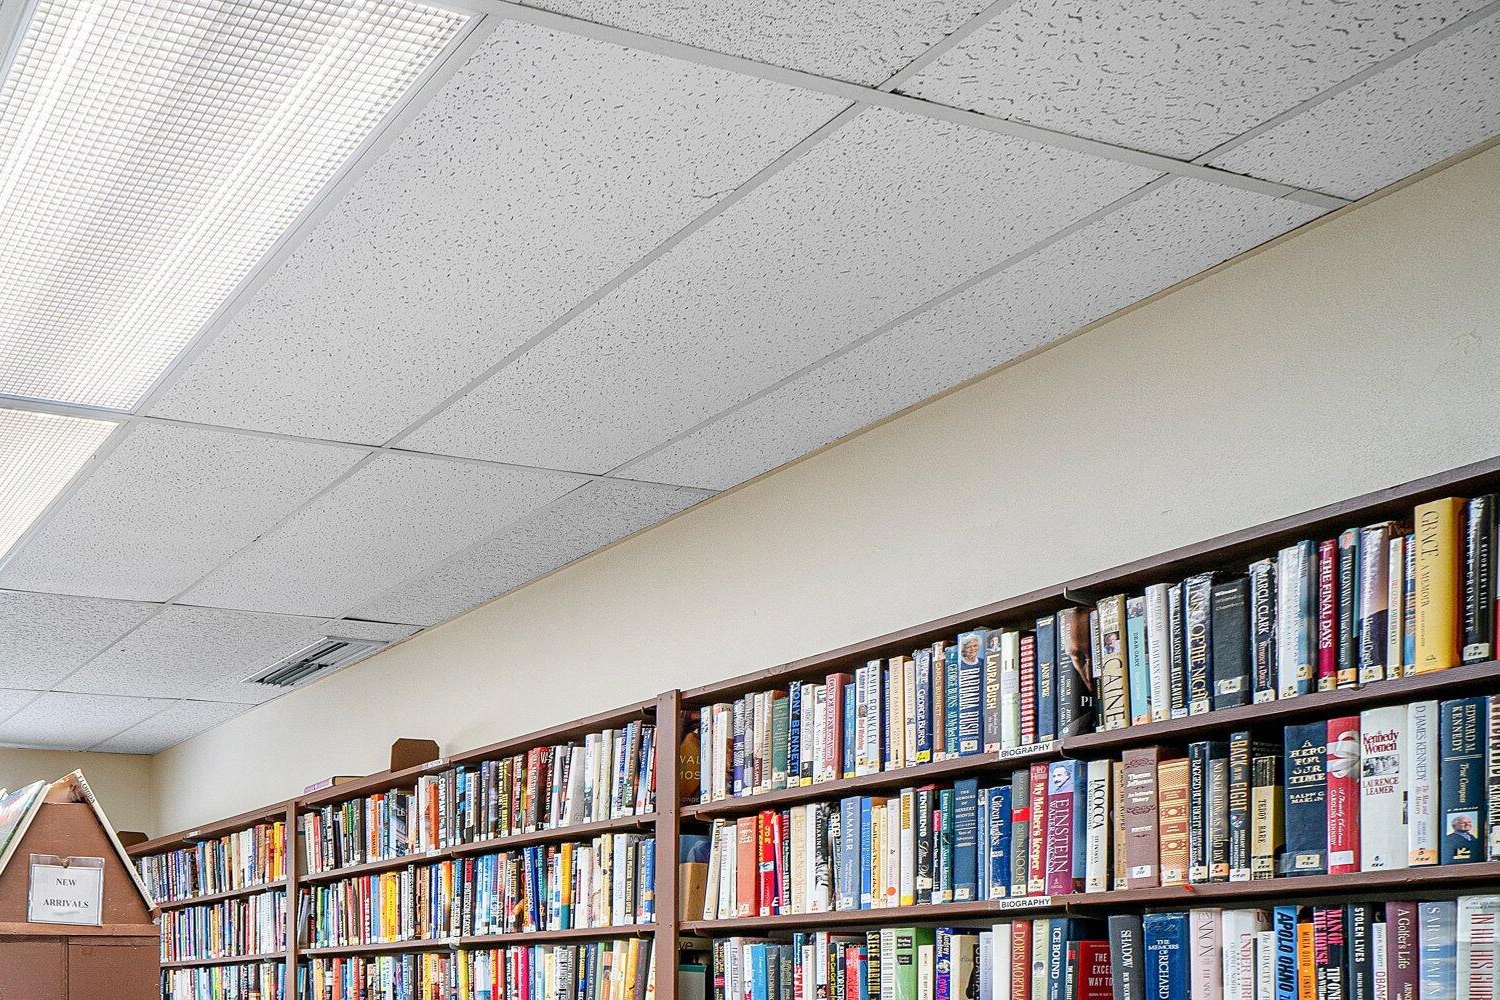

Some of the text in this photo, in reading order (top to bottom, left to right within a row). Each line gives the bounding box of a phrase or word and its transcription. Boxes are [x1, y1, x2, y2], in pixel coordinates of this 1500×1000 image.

[1340, 554, 1352, 607] TIM CONWAY
[1258, 564, 1270, 635] MARCIA CLARK
[1324, 580, 1333, 618] FINAL
[1321, 620, 1332, 649] DAYS
[986, 653, 999, 709] LAURA BUSH
[1103, 657, 1125, 725] CAINE
[959, 667, 980, 736] BARBARA BUSH
[1363, 729, 1399, 745] Kennedy
[1451, 706, 1462, 751] KENNEDY
[1465, 704, 1476, 741] EDWARD
[791, 720, 800, 774] BENNETT
[1002, 744, 1050, 757] BIOGRAPHY
[1289, 747, 1326, 758] HERO
[1294, 756, 1319, 766] FOR
[1365, 742, 1397, 756] Women
[1415, 716, 1426, 781] JAMES KENNEDY
[1127, 779, 1153, 787] Jefferson
[1231, 740, 1248, 811] BACK FIGHT
[1289, 773, 1325, 784] TIME
[1363, 776, 1399, 789] LAURENCE
[1093, 778, 1105, 830] IACOCCA
[1366, 786, 1394, 796] LEAMER
[1258, 799, 1267, 820] TEDDY
[846, 802, 854, 852] HAMMER
[1032, 783, 1044, 870] My Mother's Keeper
[1055, 798, 1068, 872] EINSTEIN
[1016, 850, 1025, 883] NOOR
[56, 878, 77, 886] NEW
[43, 899, 89, 909] ARRIVALS
[1001, 899, 1050, 908] BIOGRAPHY
[1277, 912, 1293, 954] APOLO
[1471, 913, 1494, 924] IN
[868, 932, 880, 960] STEVE
[1014, 932, 1025, 961] DORIS
[1121, 929, 1133, 968] SHADOW
[1354, 908, 1364, 962] STOLEN LIVES
[1470, 929, 1494, 945] ALL
[1095, 953, 1107, 961] THE
[1398, 951, 1410, 969] Life
[1427, 906, 1441, 995] SARAH PALIN
[1470, 951, 1494, 969] HIS
[1088, 978, 1102, 986] WAY
[1158, 955, 1169, 999] RICHARD
[1278, 956, 1294, 992] OHNO
[1327, 967, 1340, 982] TIP
